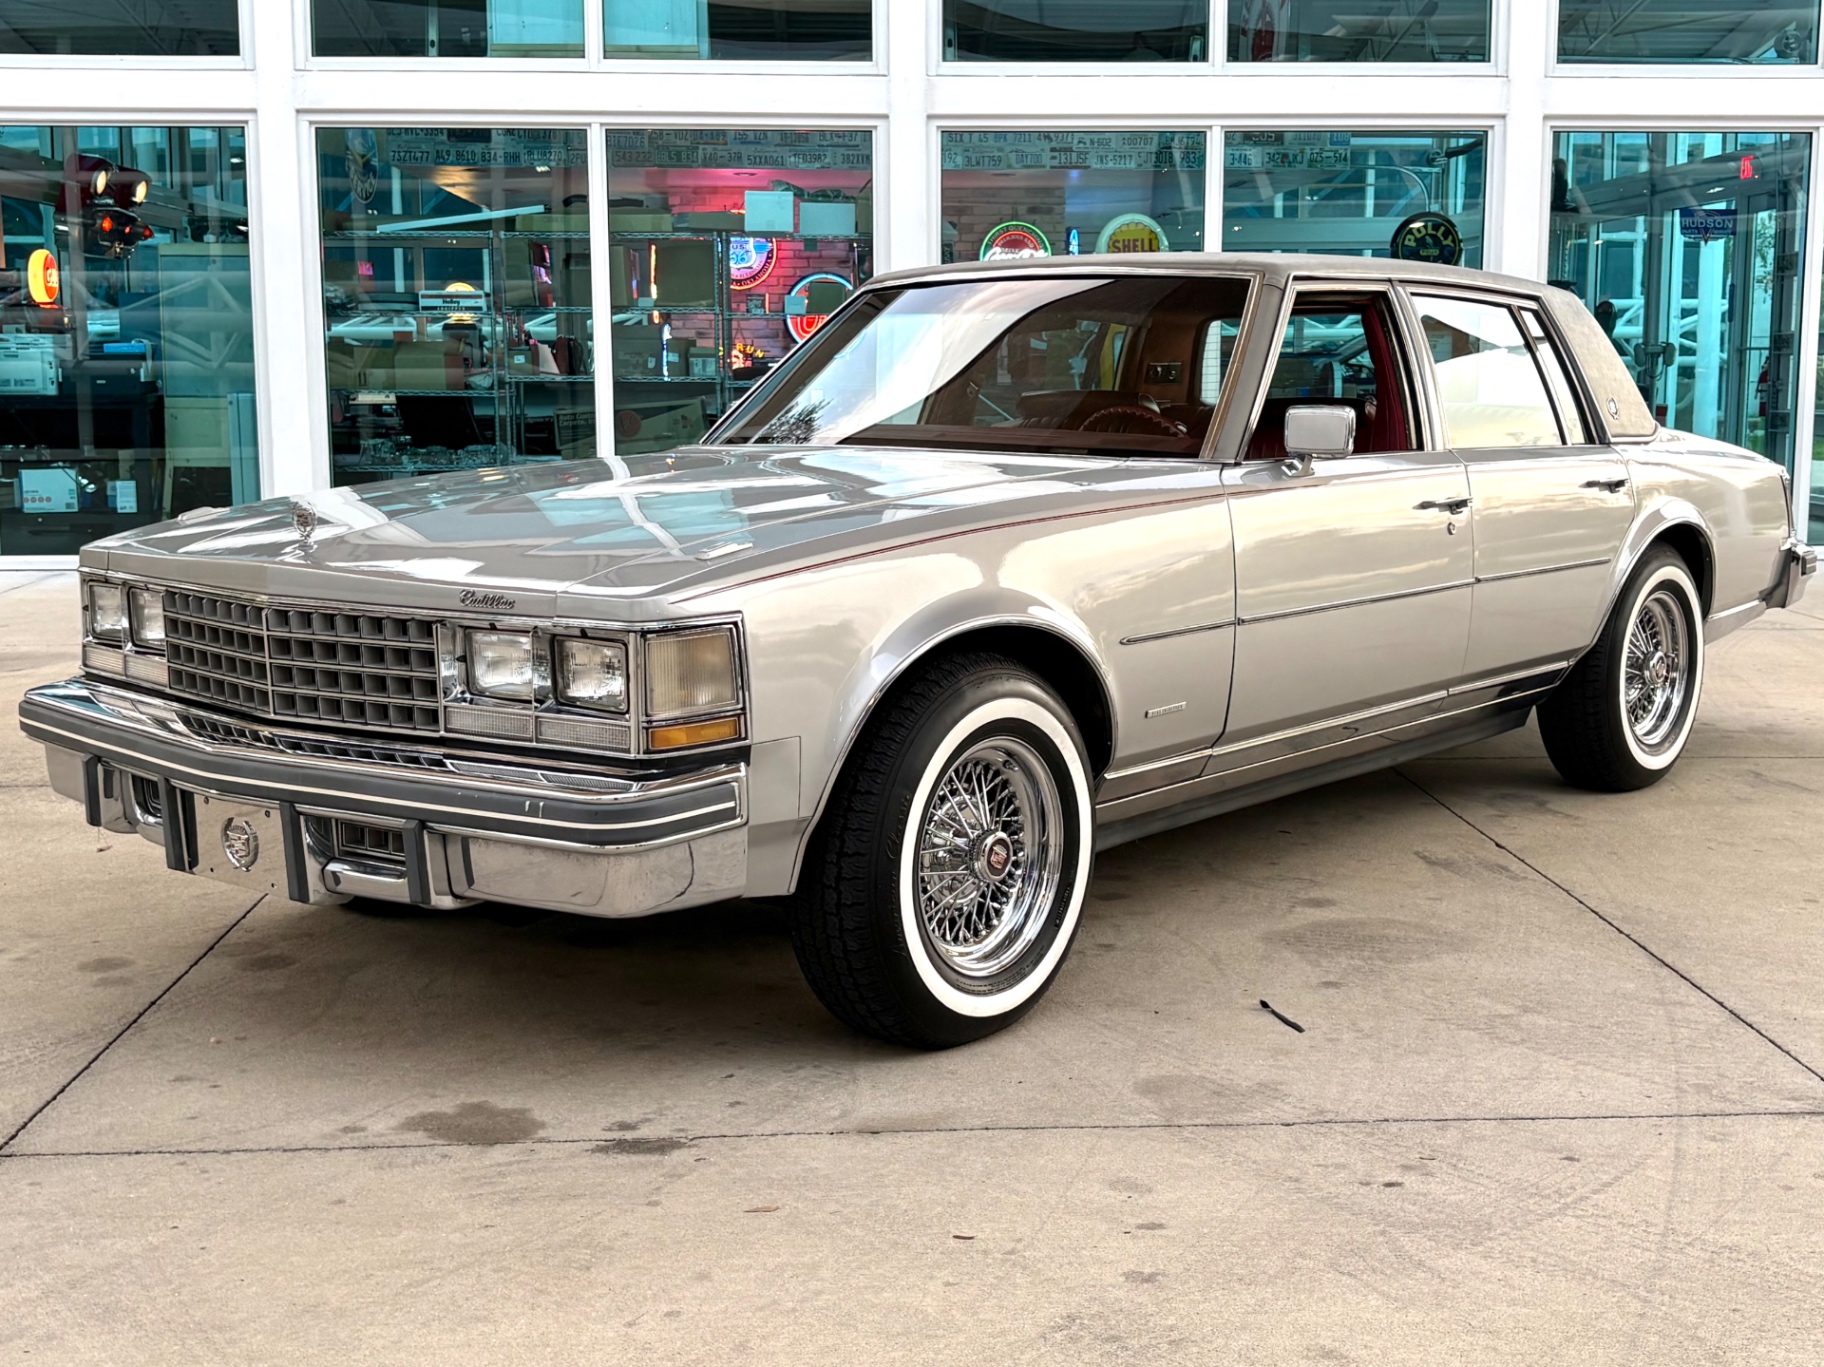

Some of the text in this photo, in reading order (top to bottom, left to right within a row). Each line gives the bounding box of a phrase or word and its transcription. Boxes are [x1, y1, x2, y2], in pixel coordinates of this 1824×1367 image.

[1681, 218, 1734, 228] HUDSON
[1404, 222, 1455, 247] POLLY
[1112, 238, 1156, 253] SHELL
[736, 343, 765, 359] RUN
[460, 589, 516, 609] Cadillac
